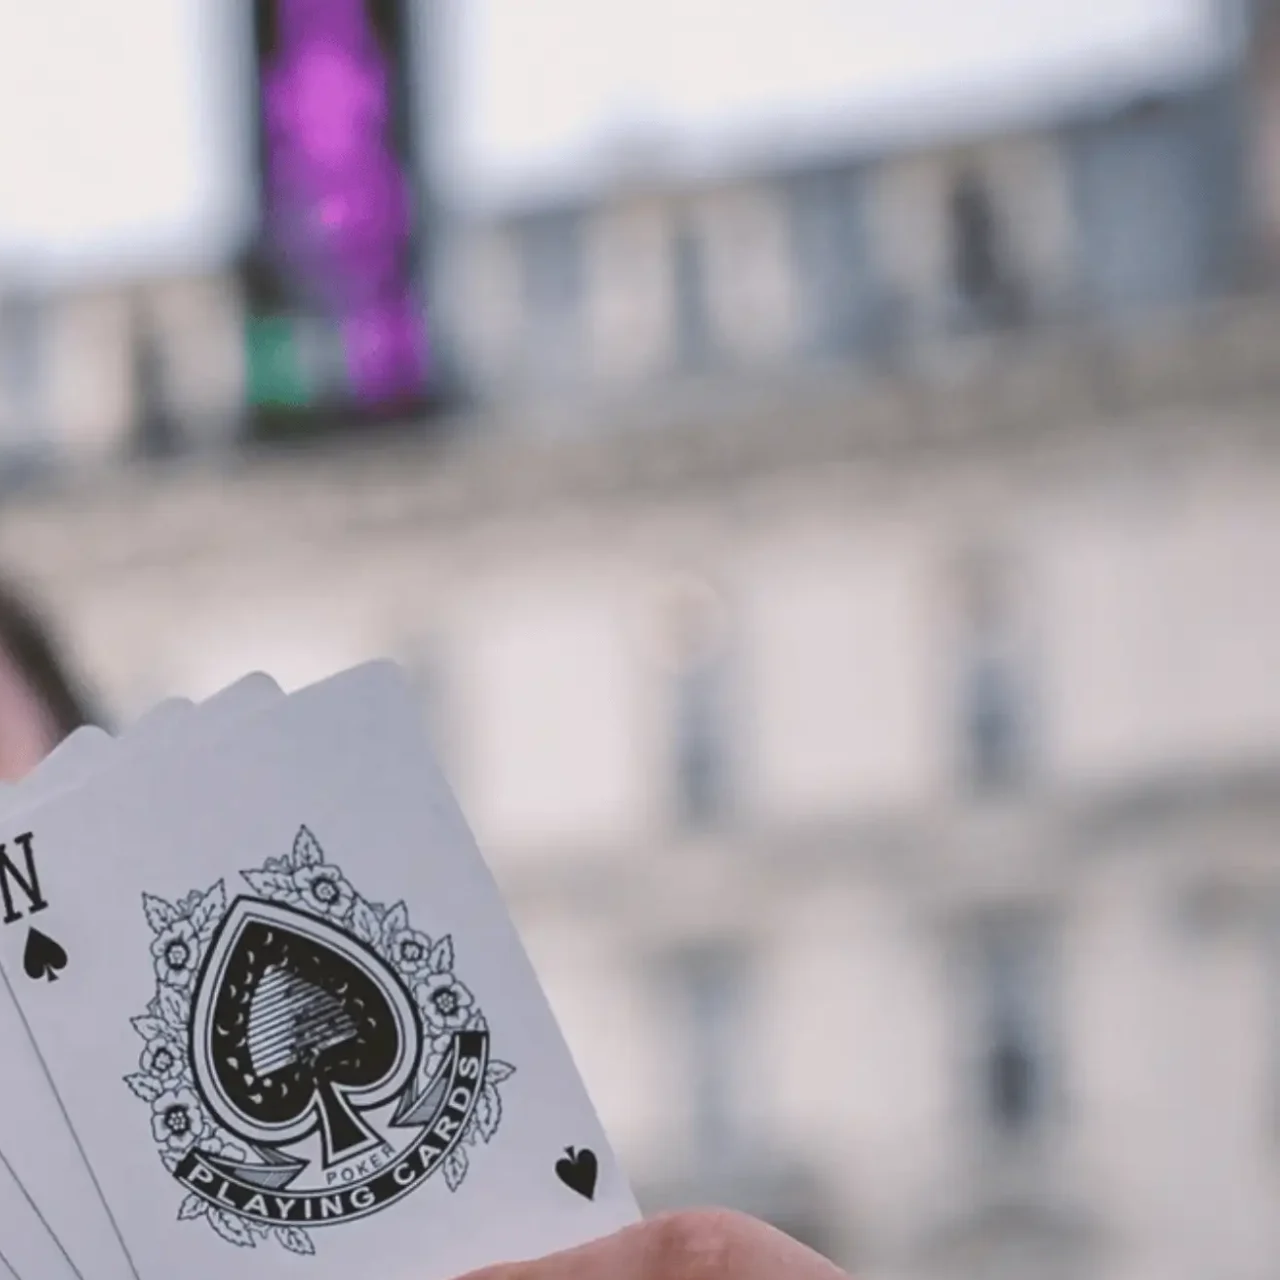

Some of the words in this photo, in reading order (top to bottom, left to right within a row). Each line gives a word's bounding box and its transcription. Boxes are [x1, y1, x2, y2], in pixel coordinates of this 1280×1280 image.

[187, 1165, 376, 1219] PLAYING
[393, 1055, 480, 1185] CARDS
[326, 1145, 396, 1185] POKER
